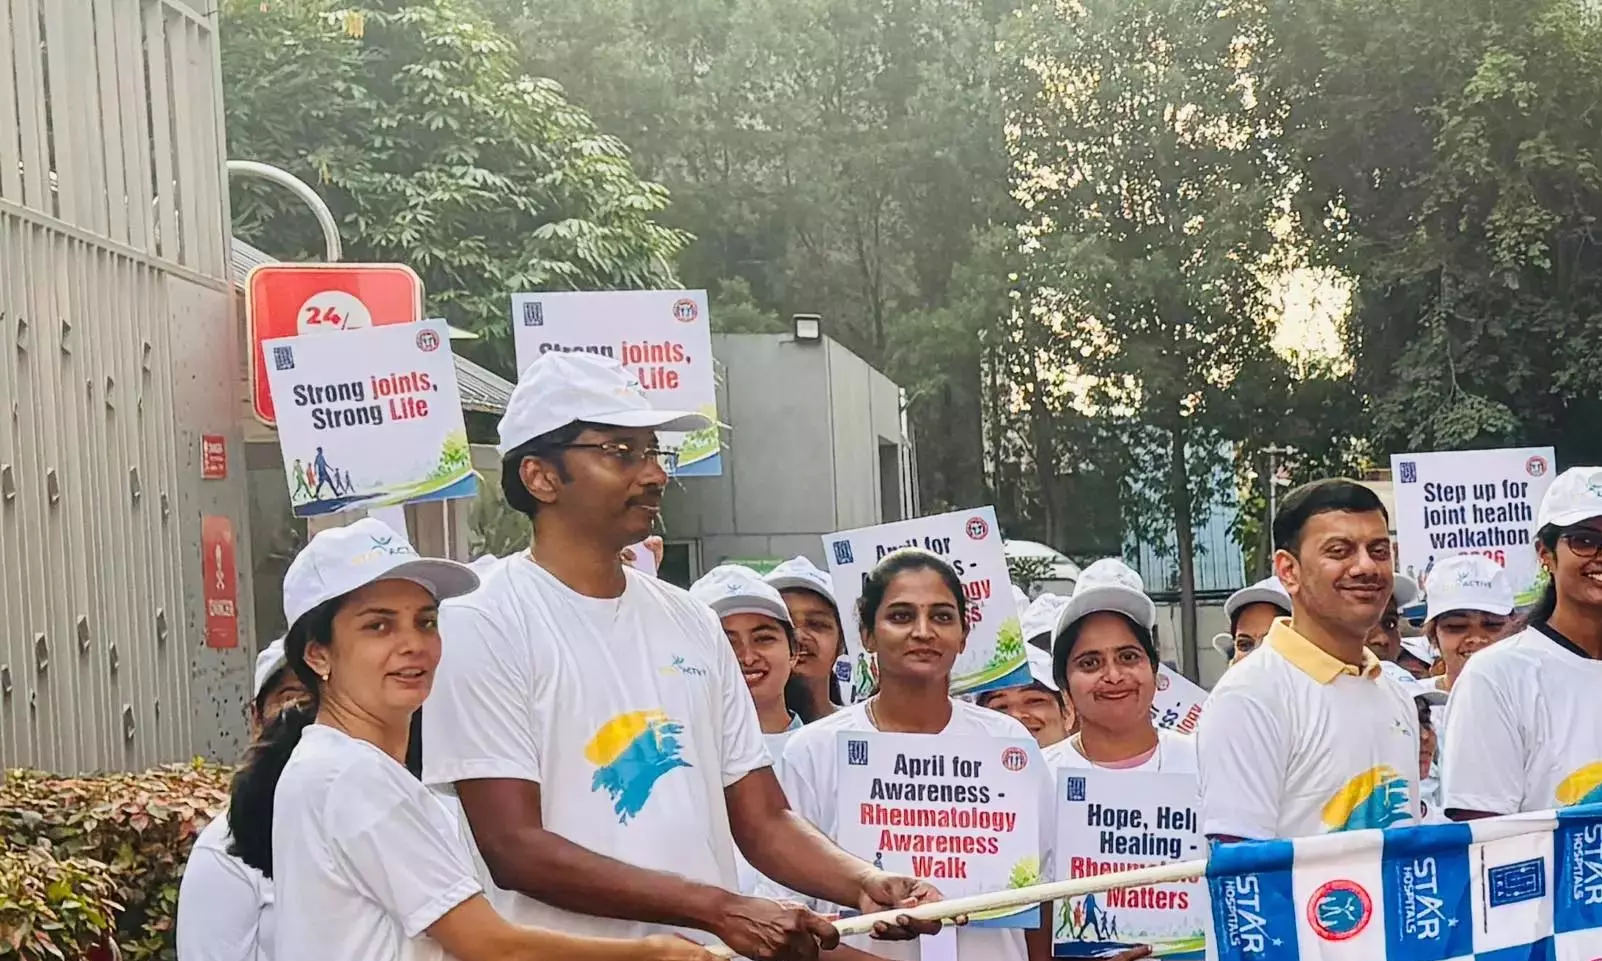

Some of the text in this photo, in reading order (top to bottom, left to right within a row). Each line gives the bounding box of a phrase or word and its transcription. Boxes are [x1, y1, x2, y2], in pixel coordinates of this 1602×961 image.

[622, 341, 691, 367] joints,
[293, 371, 438, 406] Strong joints,
[638, 366, 679, 390] Life
[312, 397, 429, 430] Strong Life
[1423, 479, 1528, 503] Step up for
[1424, 502, 1532, 529] joint health
[1429, 528, 1530, 549] walkathon
[893, 754, 982, 779] April for
[870, 778, 990, 803] Awareness
[860, 803, 1017, 832] Rheumatology
[1087, 803, 1148, 831] Hope,
[879, 830, 999, 854] Awareness
[1100, 831, 1182, 859] Healing
[912, 856, 967, 879] Walk
[1573, 833, 1584, 900] HOSPITALS
[1106, 888, 1189, 910] Matters
[1403, 866, 1418, 934] HOSPITALS
[1413, 857, 1444, 939] STAR
[1224, 880, 1242, 946] HOSPITALS
[1236, 876, 1267, 953] STAR
